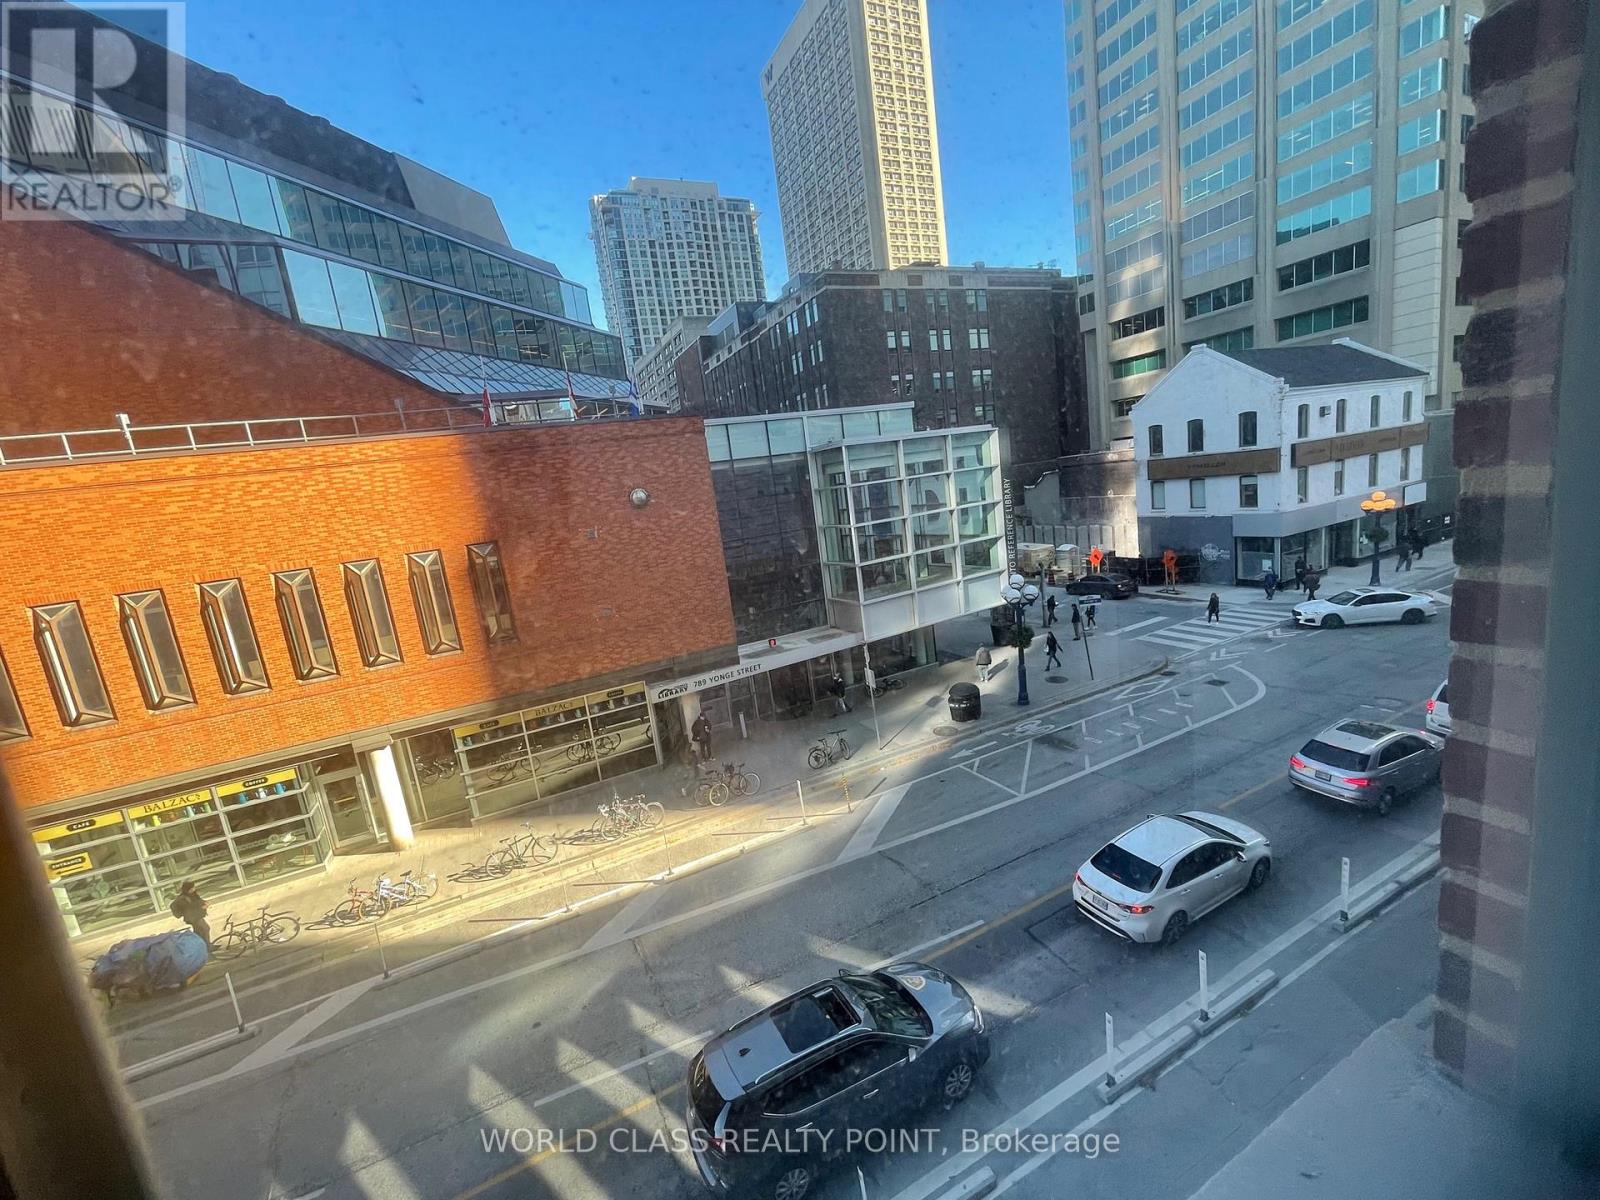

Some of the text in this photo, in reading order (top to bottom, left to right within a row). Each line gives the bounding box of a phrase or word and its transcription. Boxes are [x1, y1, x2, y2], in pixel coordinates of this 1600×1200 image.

[1003, 478, 1013, 512] LIBRARY
[1006, 512, 1016, 559] REFERENCE
[658, 687, 688, 699] LIBRARY
[693, 679, 707, 688] 789
[709, 671, 735, 683] YONGE
[736, 663, 762, 676] STREET
